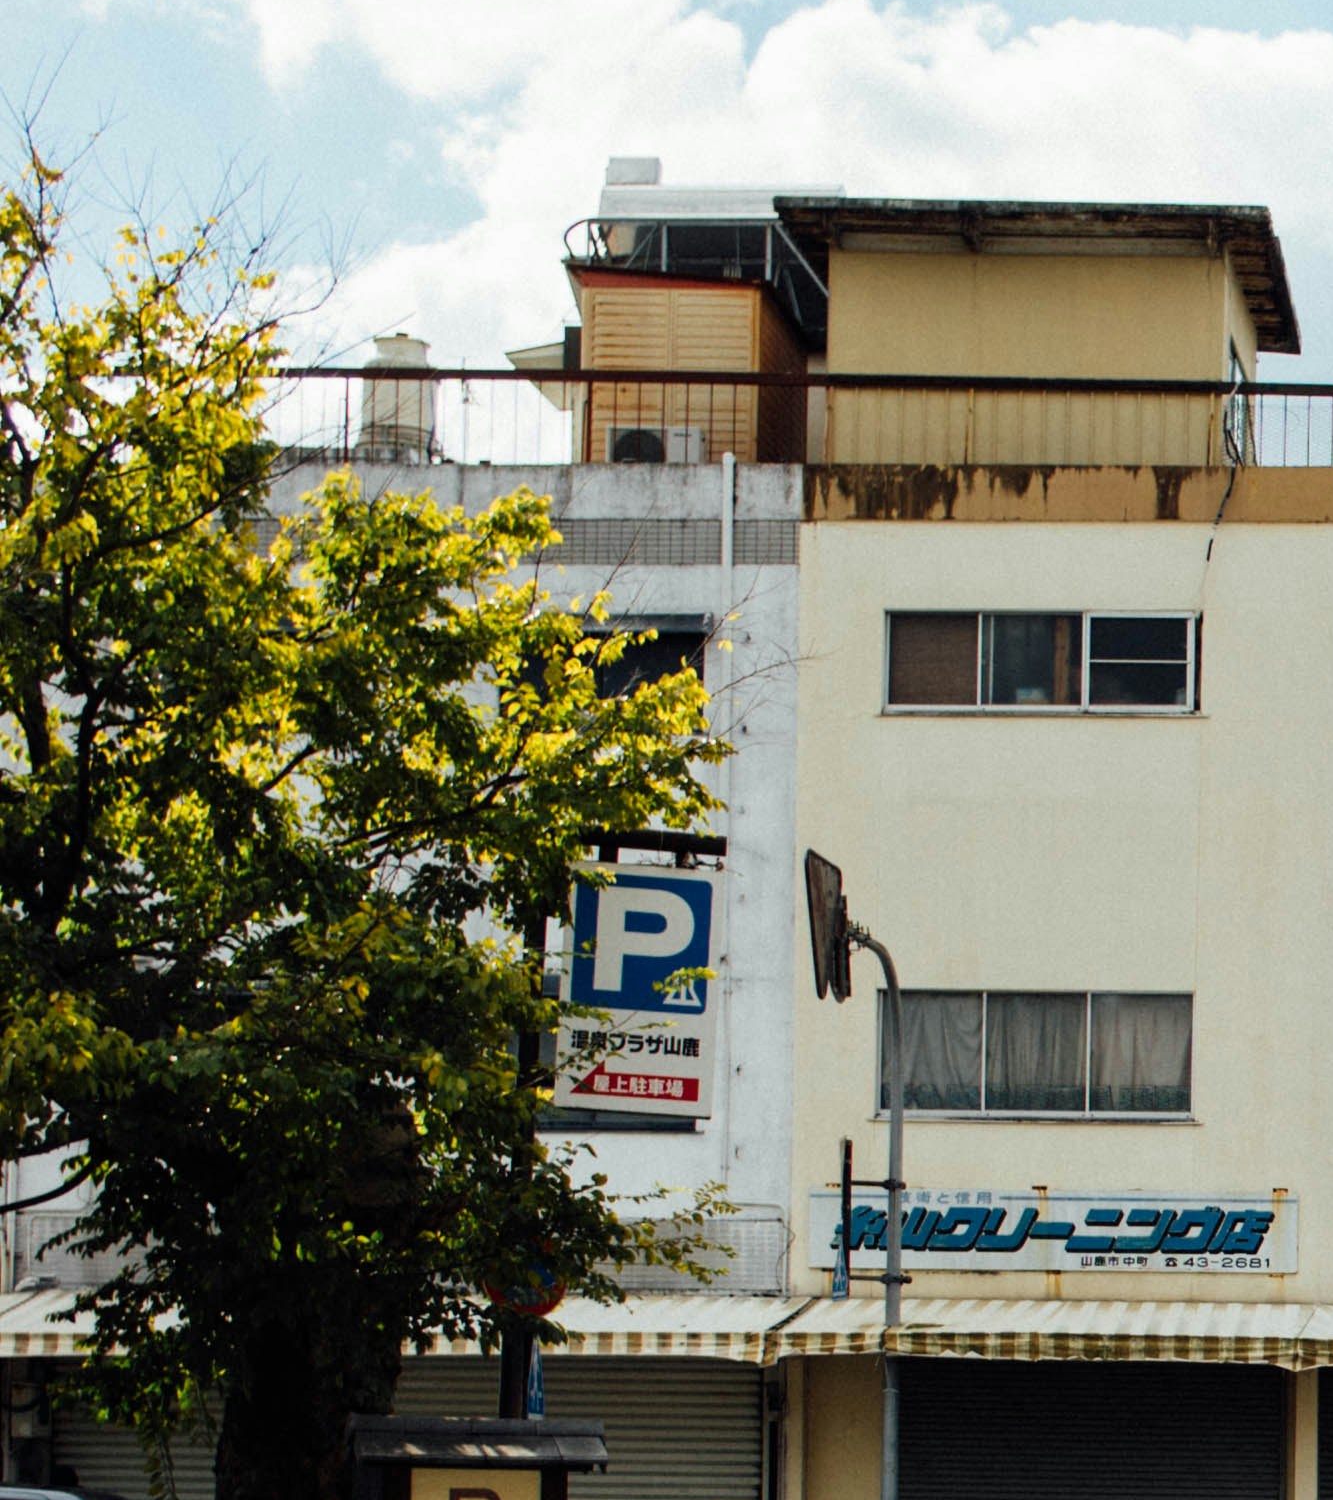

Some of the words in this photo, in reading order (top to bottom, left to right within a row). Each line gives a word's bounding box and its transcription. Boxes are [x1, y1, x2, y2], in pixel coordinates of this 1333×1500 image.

[593, 885, 695, 991] P
[571, 1029, 700, 1057] 温泉プラザ山鹿
[593, 1074, 684, 1098] 屋上駐車場
[1182, 1257, 1271, 1269] 43-2681
